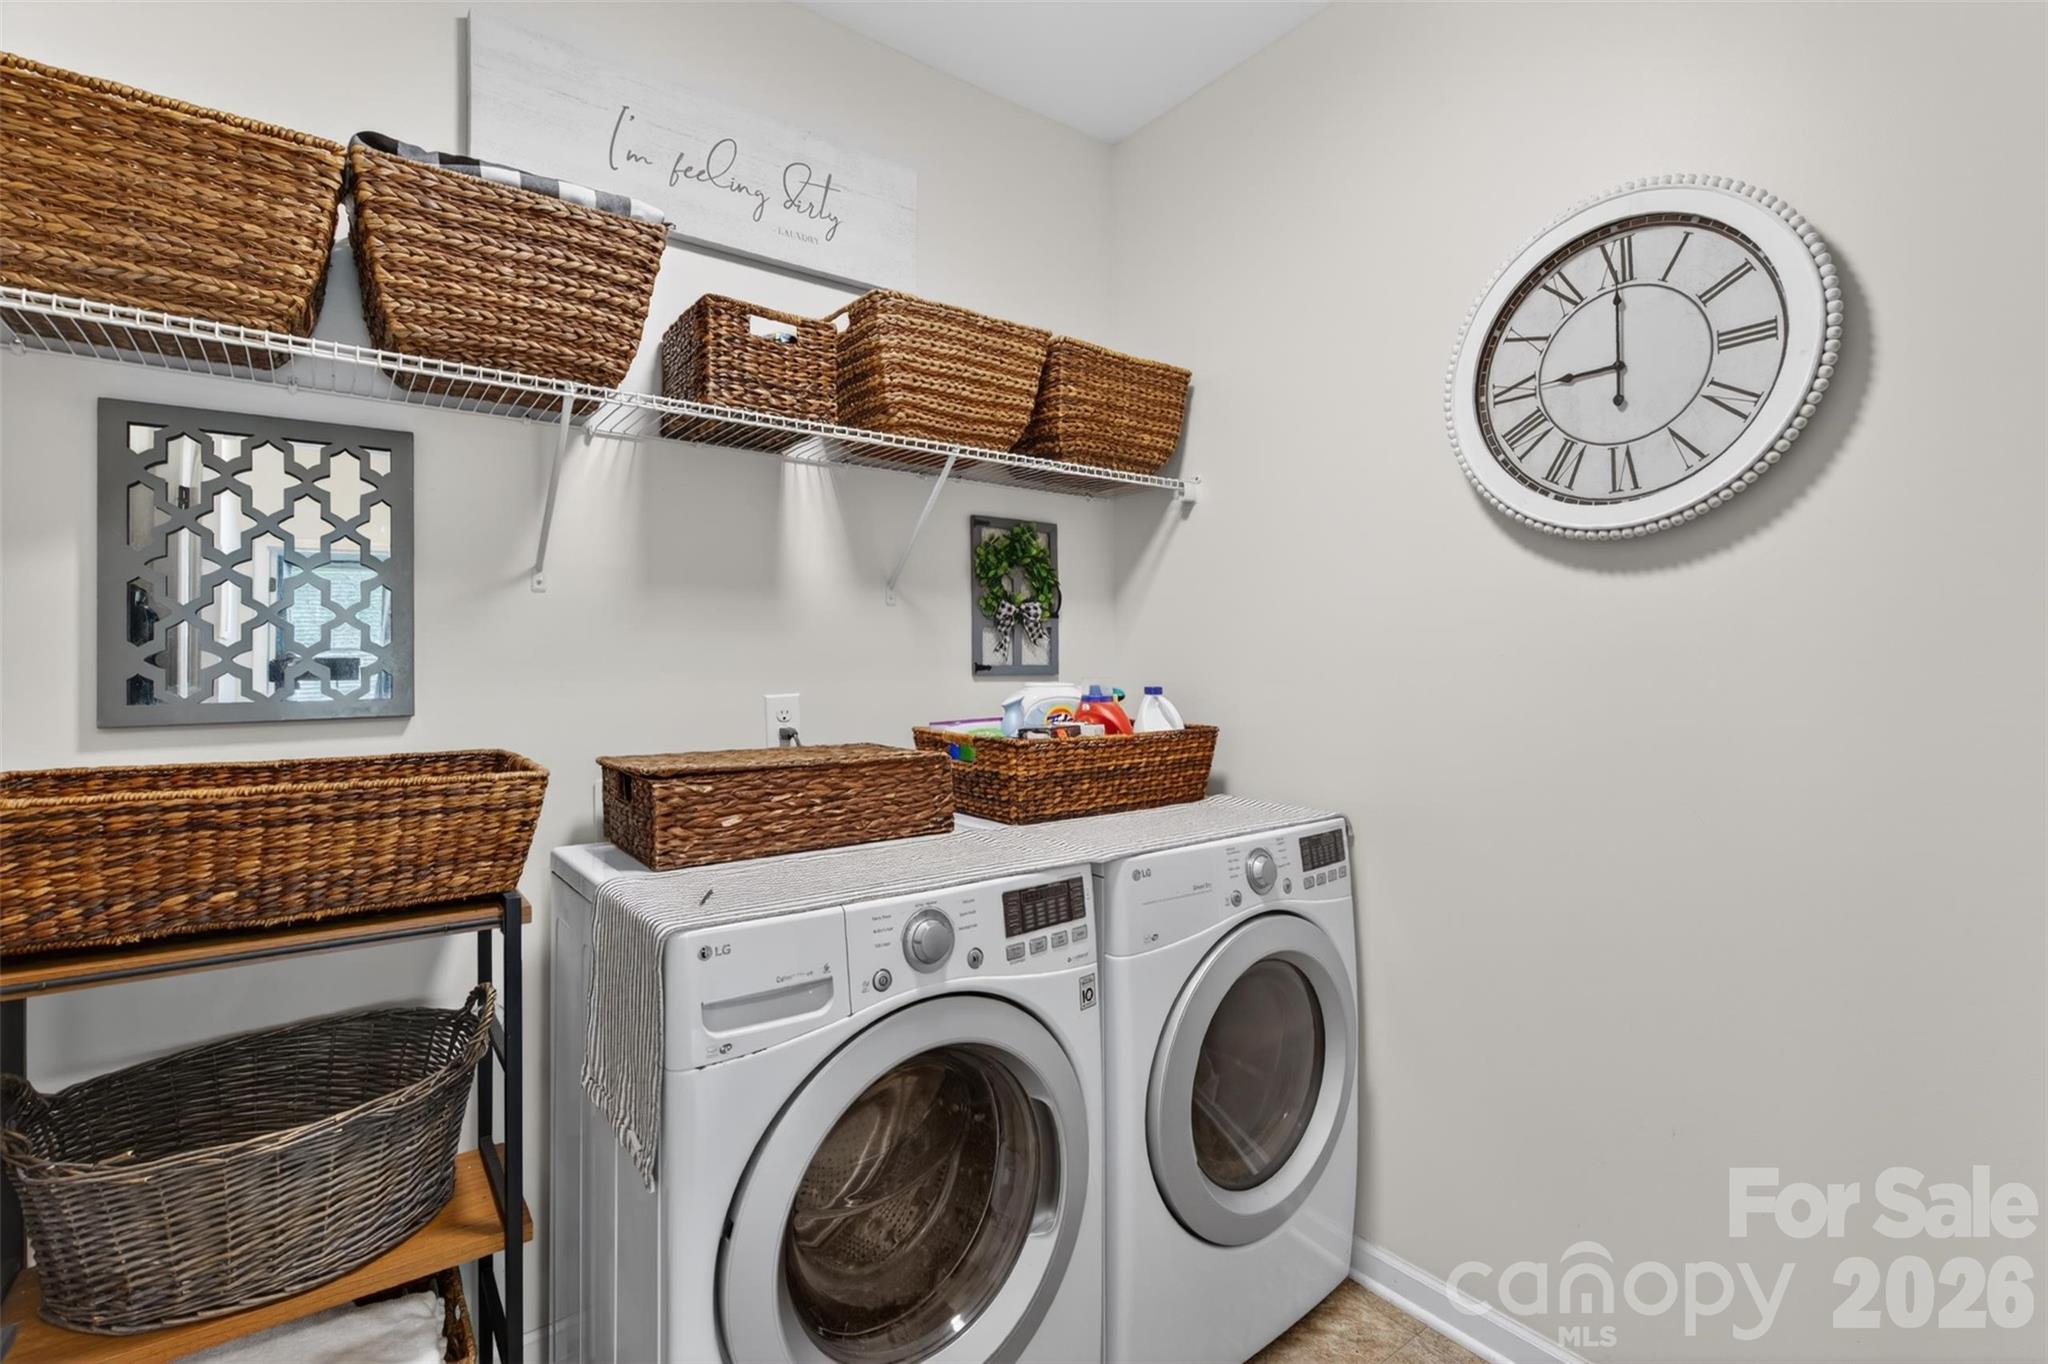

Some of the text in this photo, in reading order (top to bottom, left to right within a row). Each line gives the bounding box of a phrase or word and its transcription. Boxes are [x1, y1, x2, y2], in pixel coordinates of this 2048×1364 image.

[609, 105, 844, 241] I'm feeling dirty
[714, 944, 731, 957] LG
